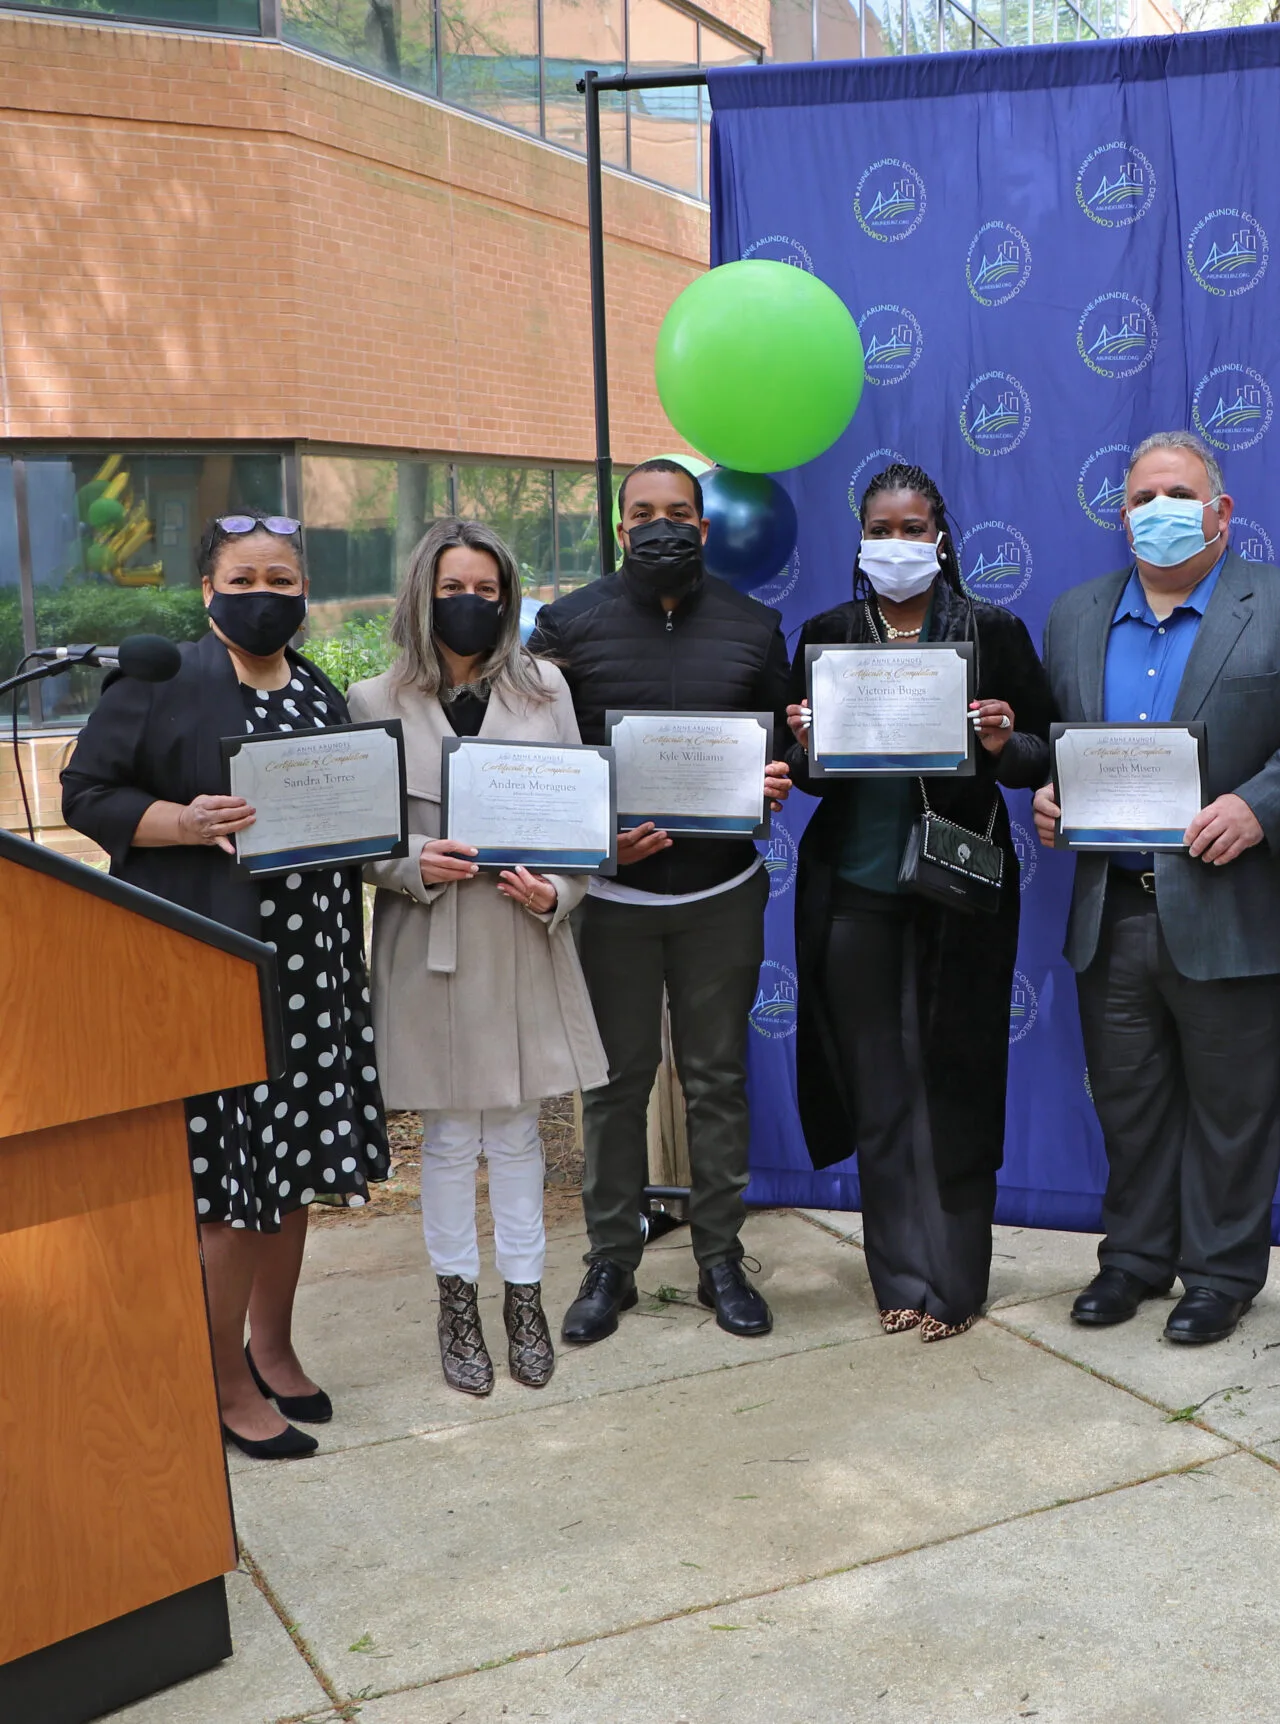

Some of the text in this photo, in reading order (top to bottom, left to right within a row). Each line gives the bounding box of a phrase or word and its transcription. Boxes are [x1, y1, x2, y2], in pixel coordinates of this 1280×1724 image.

[1093, 141, 1128, 157] ARUNDEL
[870, 158, 900, 172] ARUNDEL
[1078, 154, 1093, 176] ANNE
[1128, 146, 1156, 184] ECONOMIC
[857, 169, 870, 192] ANNE
[902, 162, 926, 200] ECONOMIC
[1076, 183, 1113, 227] CORPORATION
[1203, 208, 1240, 223] ARUNDEL
[854, 198, 888, 242] CORPORATION
[1189, 219, 1205, 244] ANNE
[756, 236, 789, 247] ARUNDEL
[1241, 212, 1269, 252] ECONOMIC
[1187, 251, 1225, 297] CORPORATION
[1094, 292, 1129, 307] ARUNDEL
[866, 304, 899, 316] ARUNDEL
[901, 308, 923, 344] ECONOMIC
[1080, 303, 1094, 326] ANNE
[1131, 295, 1158, 336] ECONOMIC
[1076, 332, 1114, 378] CORPORATION
[976, 371, 1004, 385] ARUNDEL
[1210, 363, 1244, 378] ARUNDEL
[1195, 374, 1210, 397] ANNE
[1246, 367, 1274, 408] ECONOMIC
[1192, 406, 1229, 451] CORPORATION
[1095, 444, 1131, 458] ARUNDEL
[852, 460, 866, 482] ANNE
[866, 449, 891, 462] ARUNDEL
[1082, 456, 1095, 477] ANNE
[1077, 484, 1116, 530] CORPORATION
[972, 520, 1005, 533] ARUNDEL
[1250, 521, 1274, 561] ECONOMIC
[857, 686, 926, 696] Victoria Buggs
[659, 752, 724, 762] Kyle Williams
[1100, 763, 1127, 774] Joseph
[284, 774, 355, 788] Sandra Torres
[489, 779, 576, 792] Andrea Moragues
[1011, 820, 1037, 860] ECONOMIC
[769, 822, 798, 898] ECONOMIC DEVELOPMEN
